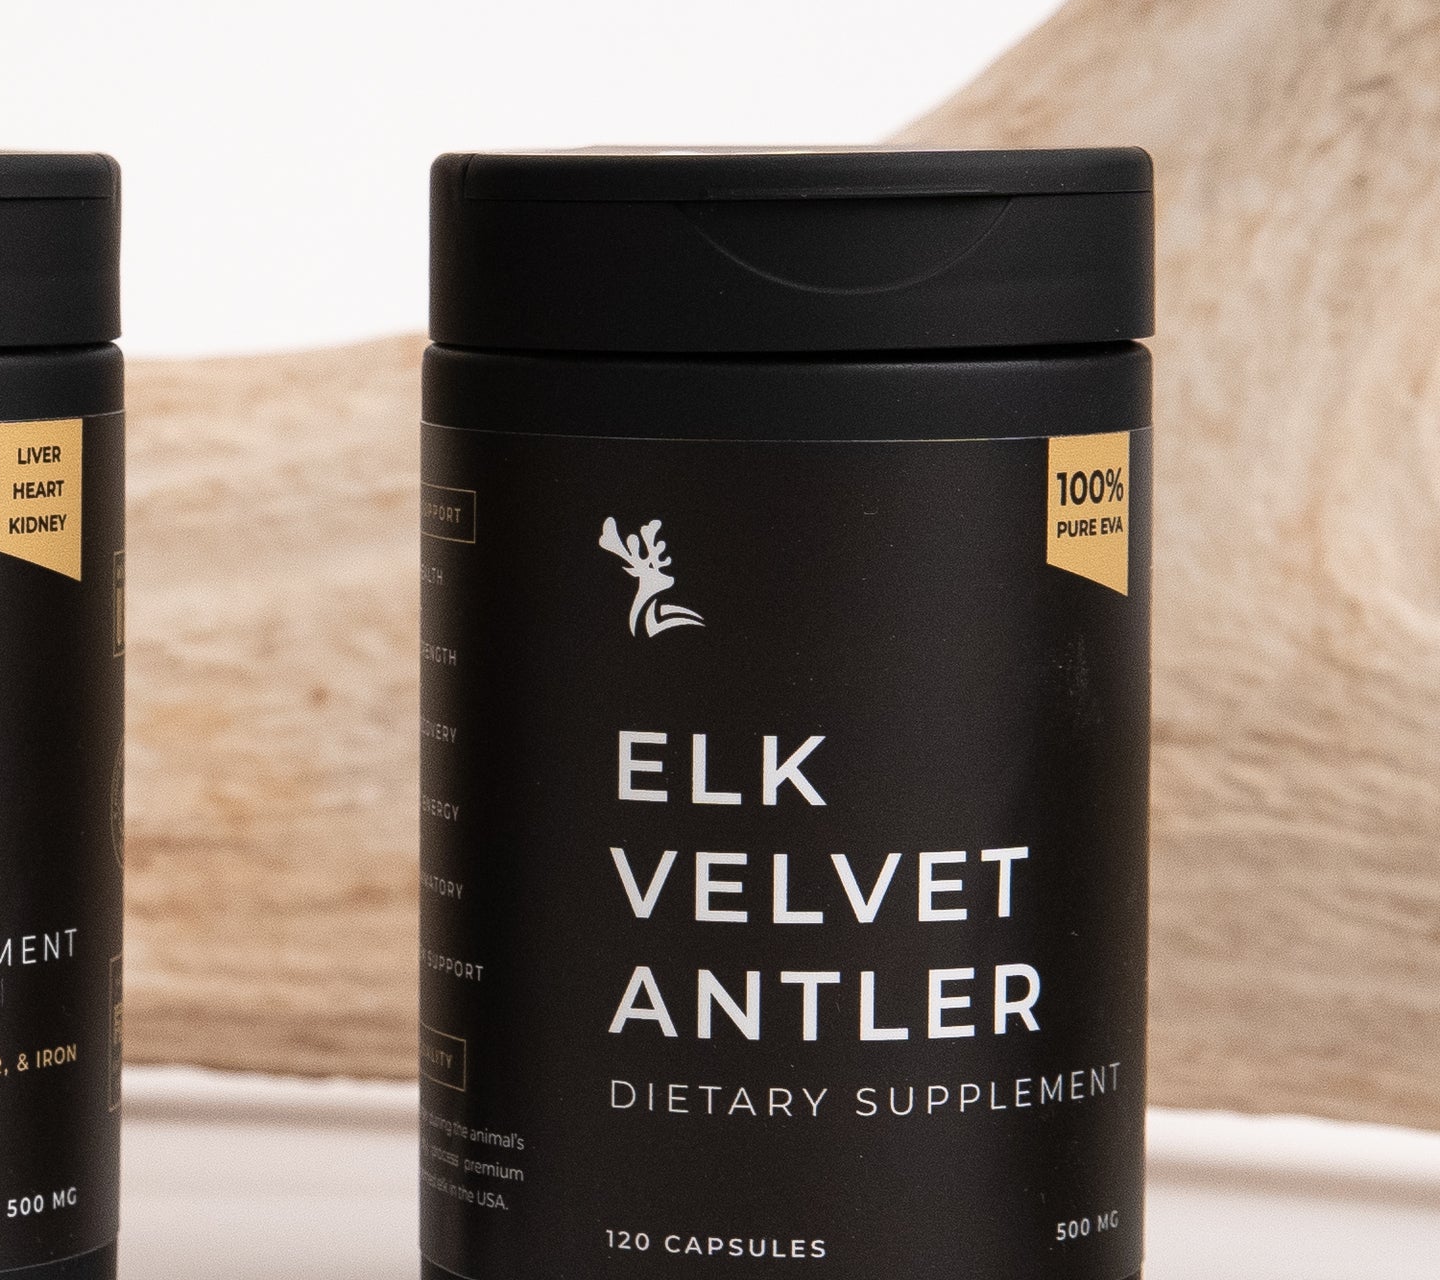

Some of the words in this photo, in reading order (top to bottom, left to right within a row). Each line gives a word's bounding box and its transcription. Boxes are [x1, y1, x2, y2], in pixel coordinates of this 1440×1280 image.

[16, 446, 62, 465] LIVER
[11, 479, 65, 500] HEART
[1055, 466, 1125, 508] 100%
[8, 513, 68, 536] KIDNEY
[1056, 518, 1098, 539] PURE
[1100, 516, 1124, 537] EVA
[618, 730, 827, 807] ELK
[609, 846, 1030, 924] VELVET
[608, 963, 1042, 1042] ANTLER
[16, 1052, 30, 1071] &
[35, 1043, 78, 1070] IRON
[610, 1079, 830, 1118] DIETARY
[855, 1061, 1121, 1117] SUPPLEMENT
[469, 1127, 525, 1151] animal's
[463, 1158, 525, 1182] premium
[6, 1193, 45, 1219] 500
[52, 1186, 78, 1210] MG
[476, 1191, 510, 1211] USA.
[1055, 1217, 1091, 1242] 500
[1098, 1210, 1120, 1233] MG
[605, 1228, 651, 1252] 120
[664, 1234, 827, 1259] CAPSULES
